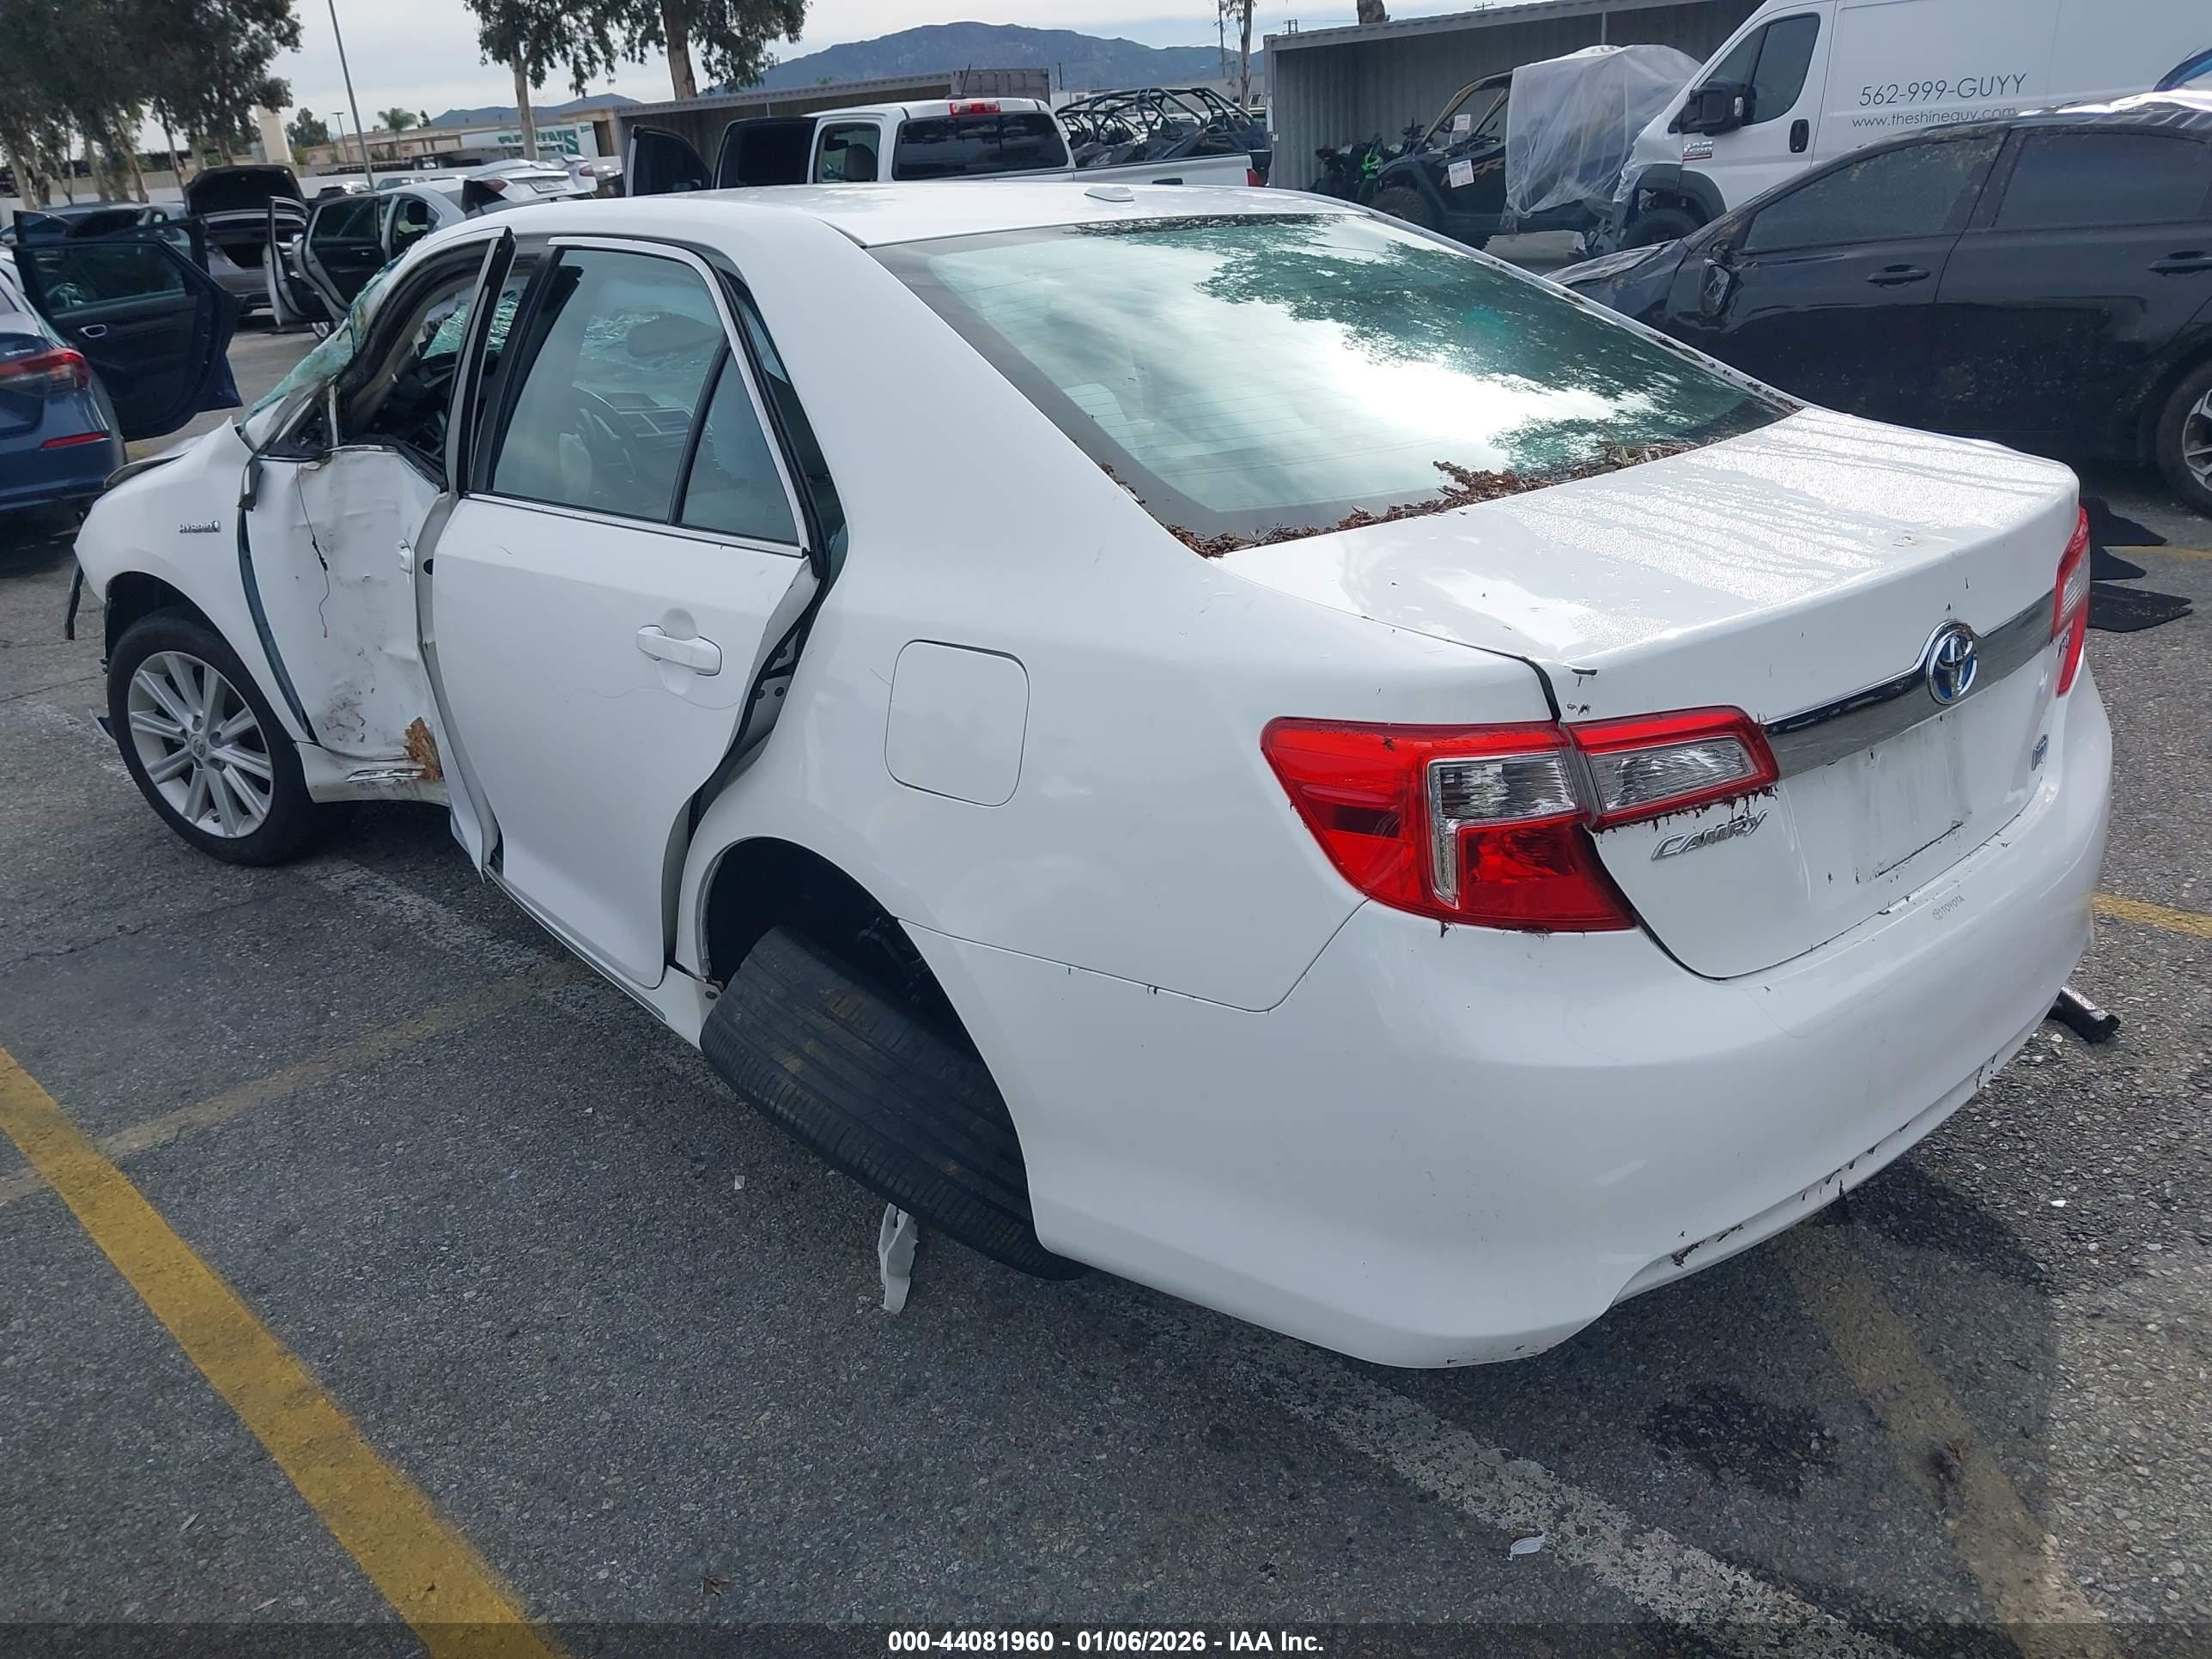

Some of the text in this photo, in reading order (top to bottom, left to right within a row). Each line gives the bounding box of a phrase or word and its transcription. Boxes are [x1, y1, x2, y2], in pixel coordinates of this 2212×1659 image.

[1859, 73, 2027, 106] 562-999-GUYY
[1651, 810, 1769, 860] CAMRY
[1942, 895, 1966, 915] TOYOTA
